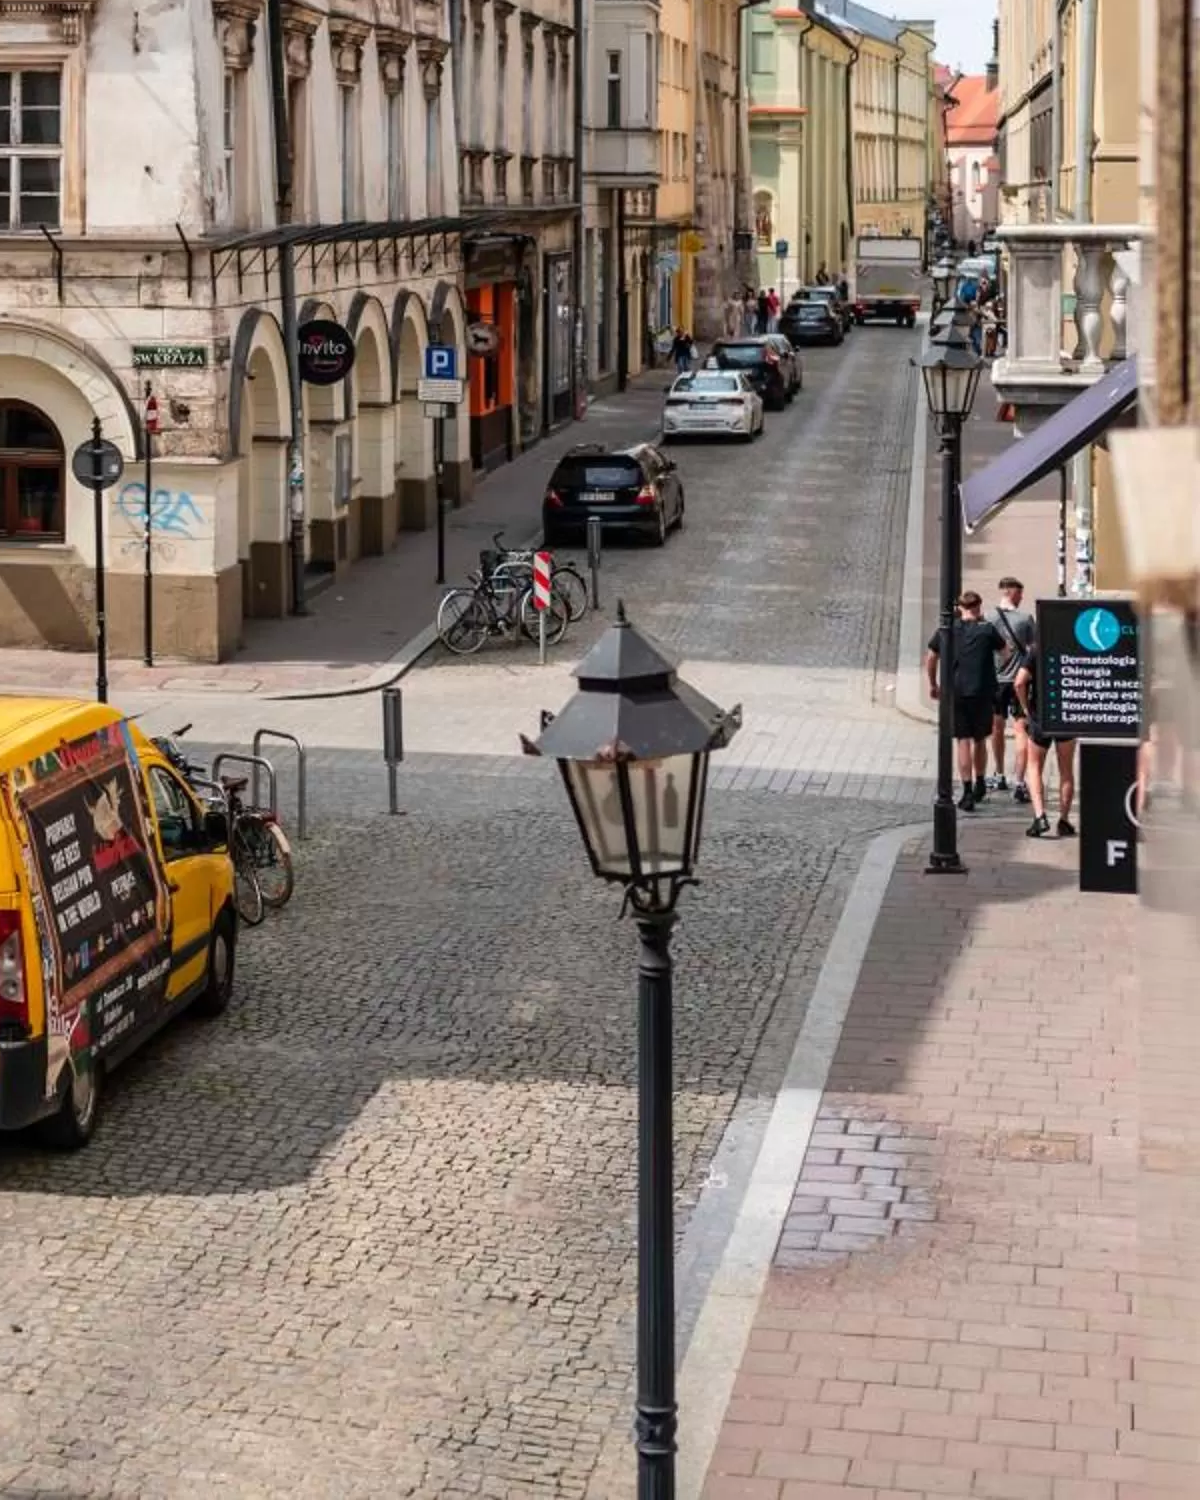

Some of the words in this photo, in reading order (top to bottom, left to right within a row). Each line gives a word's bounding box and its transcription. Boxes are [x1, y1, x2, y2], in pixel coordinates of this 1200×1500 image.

[432, 350, 448, 375] P
[1061, 655, 1136, 667] Dermatologia
[1061, 666, 1111, 678] Chirurgia
[1061, 678, 1111, 689] Chirurgia
[1062, 690, 1119, 700] Medycyna
[1062, 701, 1137, 712] Kosmetologia
[1062, 712, 1142, 724] Laseroterapi
